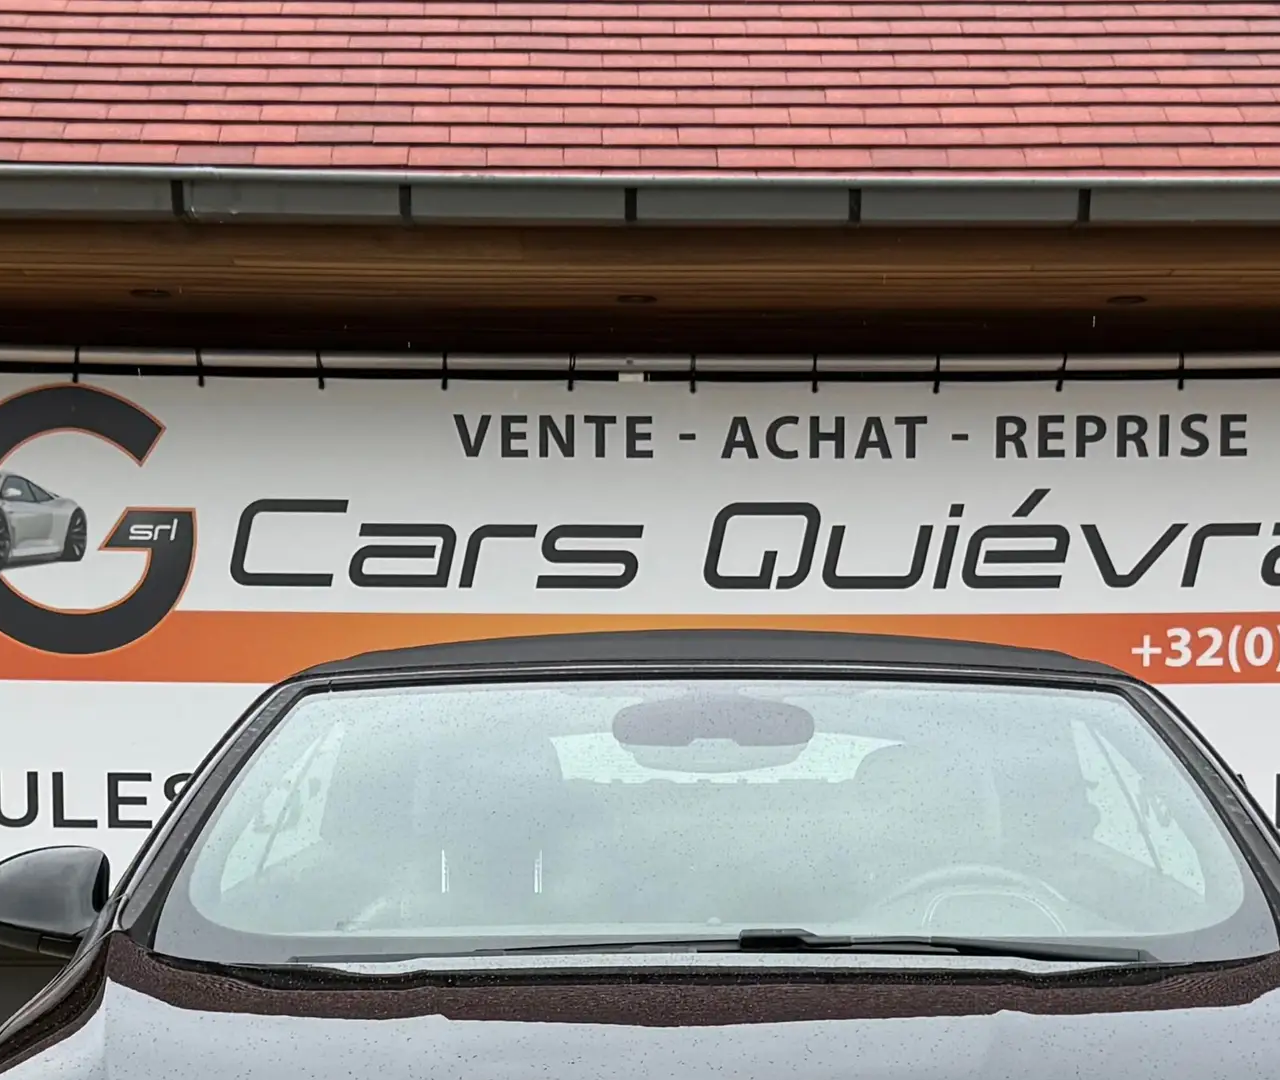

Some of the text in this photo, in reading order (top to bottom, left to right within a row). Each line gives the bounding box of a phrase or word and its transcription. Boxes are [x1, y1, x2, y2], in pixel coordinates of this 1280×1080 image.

[452, 413, 1248, 460] VENTE - ACHAT - REPRISE
[128, 518, 178, 541] srl
[229, 498, 645, 589] Cars
